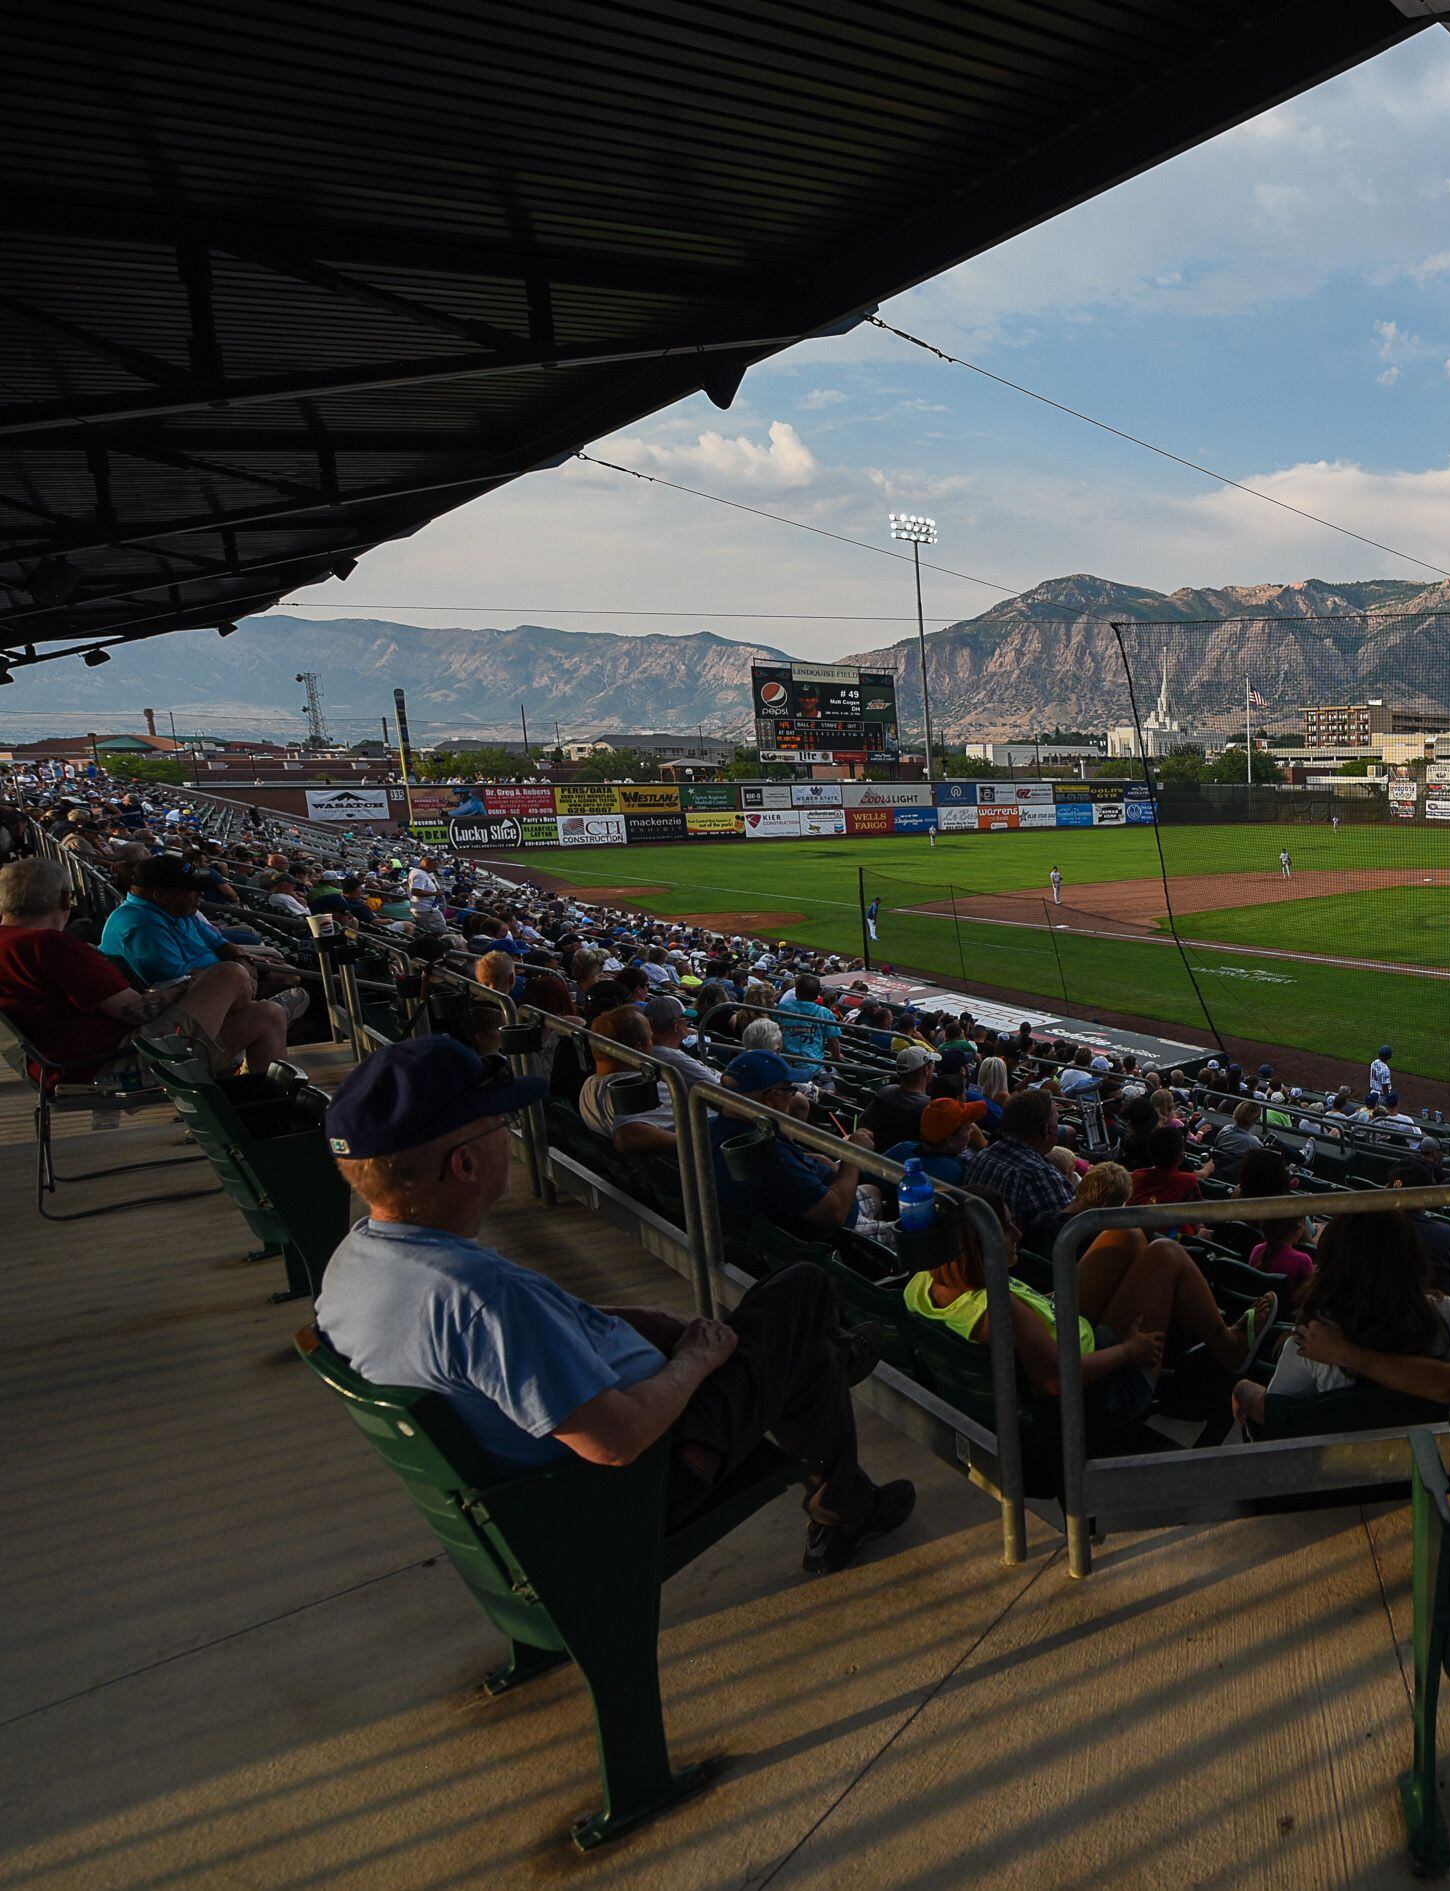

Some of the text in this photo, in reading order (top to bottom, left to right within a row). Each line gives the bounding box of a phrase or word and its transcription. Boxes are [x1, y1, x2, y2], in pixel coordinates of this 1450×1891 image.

[793, 668, 859, 679] LINDQUIST FIELD
[848, 690, 859, 698] 49
[761, 707, 789, 719] pepsi
[391, 790, 404, 800] 335
[497, 789, 515, 797] Greg
[523, 788, 551, 796] Roberts
[860, 791, 919, 804] Coors LIGHT
[853, 812, 887, 821] WELLS
[978, 807, 1018, 816] warrens
[630, 817, 682, 827] mackenzie
[855, 821, 887, 830] FARGO
[585, 820, 621, 836] CTI
[454, 824, 517, 843] Lucky Slice
[562, 834, 624, 844] CONSTRUCTION
